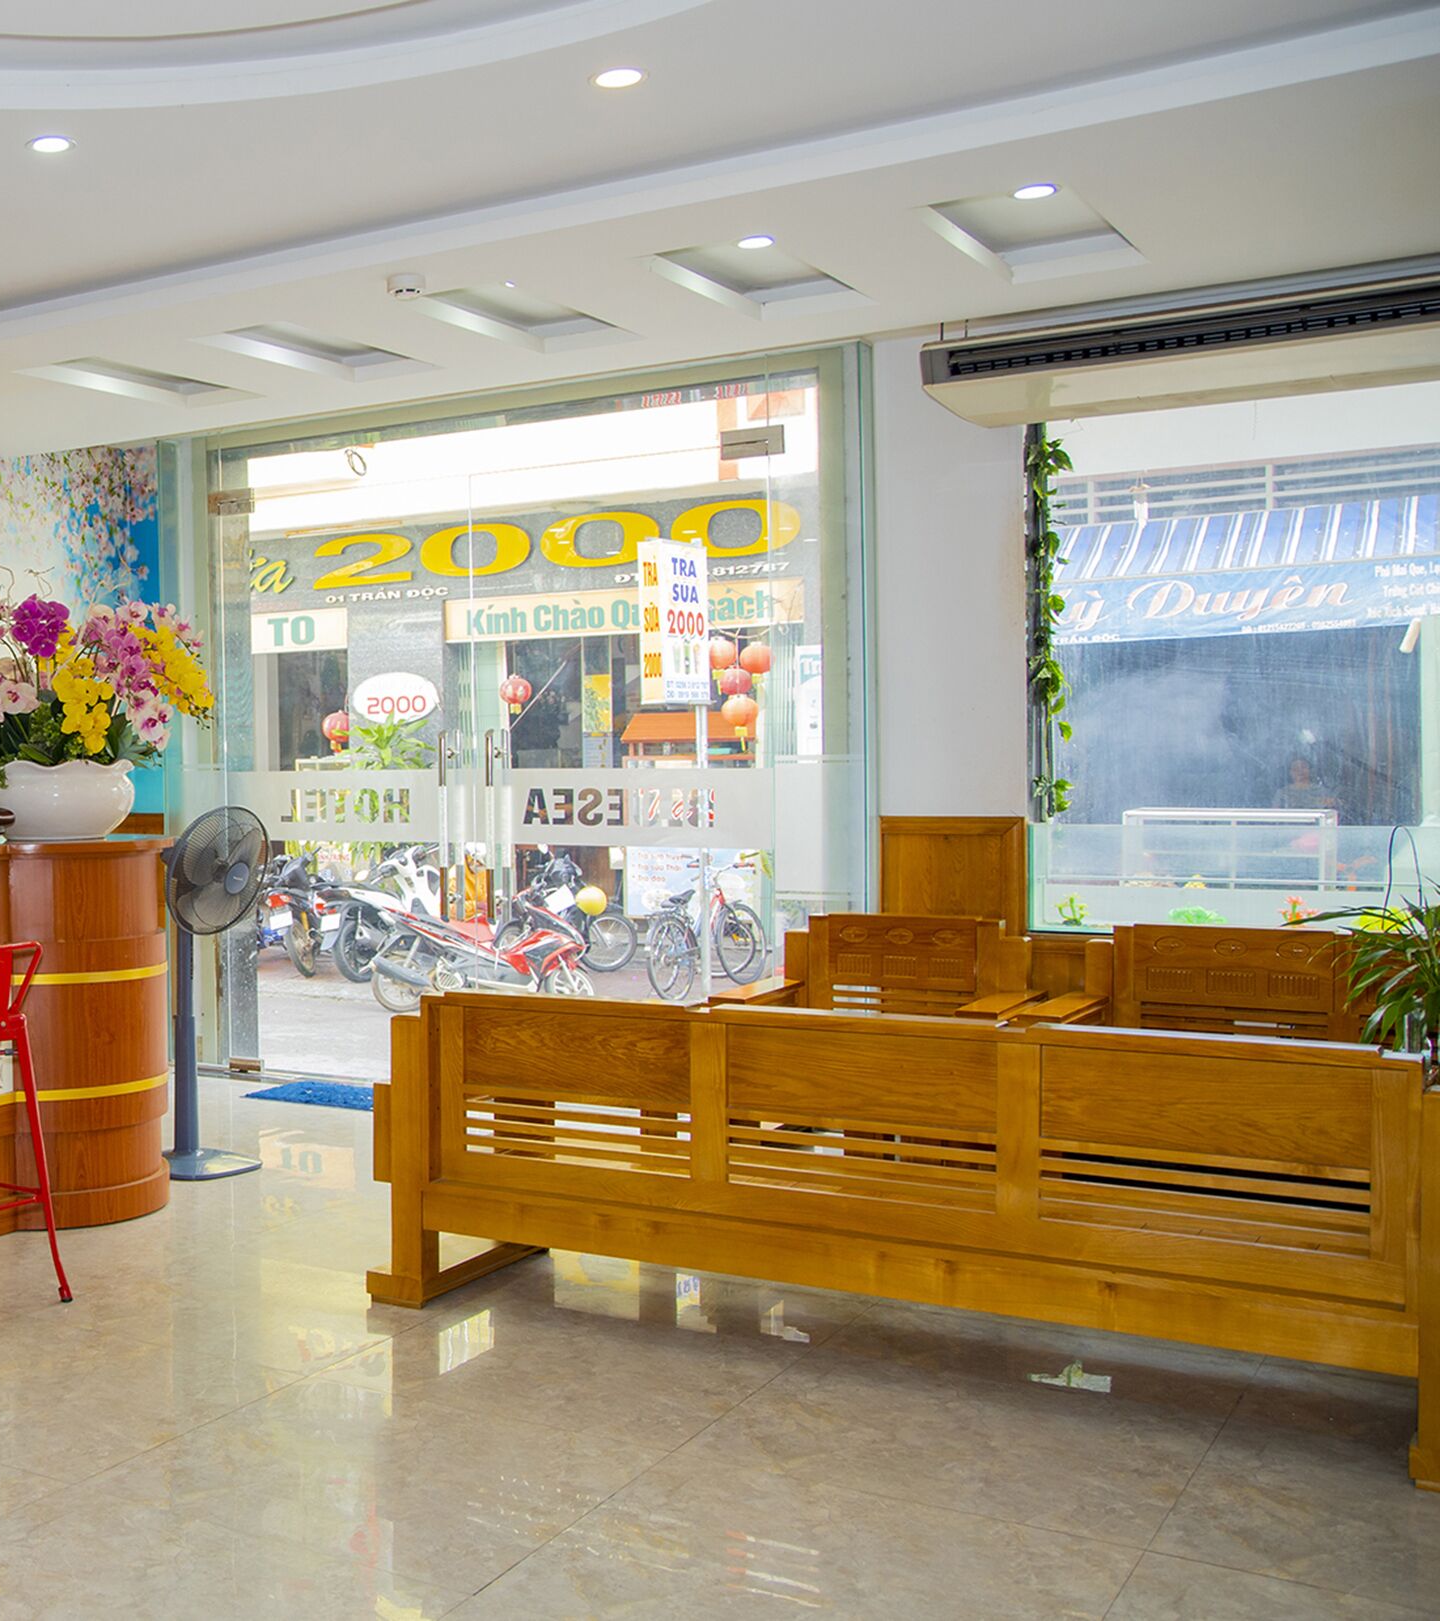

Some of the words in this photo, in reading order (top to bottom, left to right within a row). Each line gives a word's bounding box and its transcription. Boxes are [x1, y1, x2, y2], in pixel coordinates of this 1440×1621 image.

[313, 499, 801, 590] 2000
[325, 595, 345, 604] 01
[1126, 575, 1353, 621] Duyên
[267, 615, 315, 647] TO
[467, 604, 527, 635] Kính
[533, 599, 605, 632] Chào
[667, 609, 705, 637] 2000
[367, 694, 426, 715] 2000
